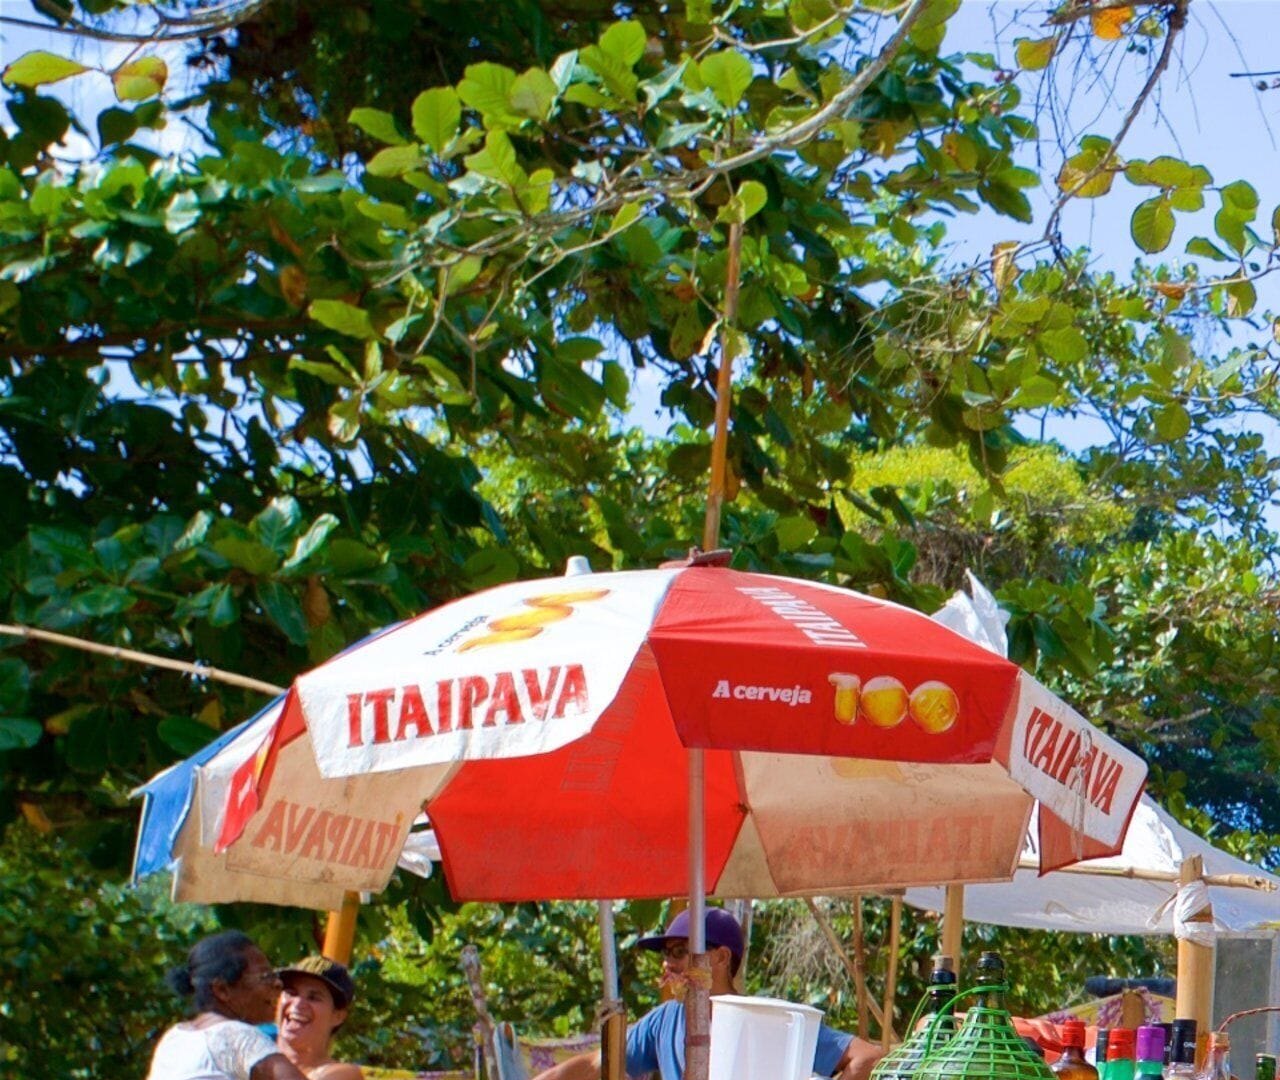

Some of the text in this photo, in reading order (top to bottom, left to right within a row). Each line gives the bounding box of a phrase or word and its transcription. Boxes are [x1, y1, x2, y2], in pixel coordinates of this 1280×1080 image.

[346, 664, 590, 748] ITAIPAVA
[712, 680, 730, 699] A
[733, 682, 812, 706] cerveja
[1023, 705, 1125, 815] ITAIPAVA
